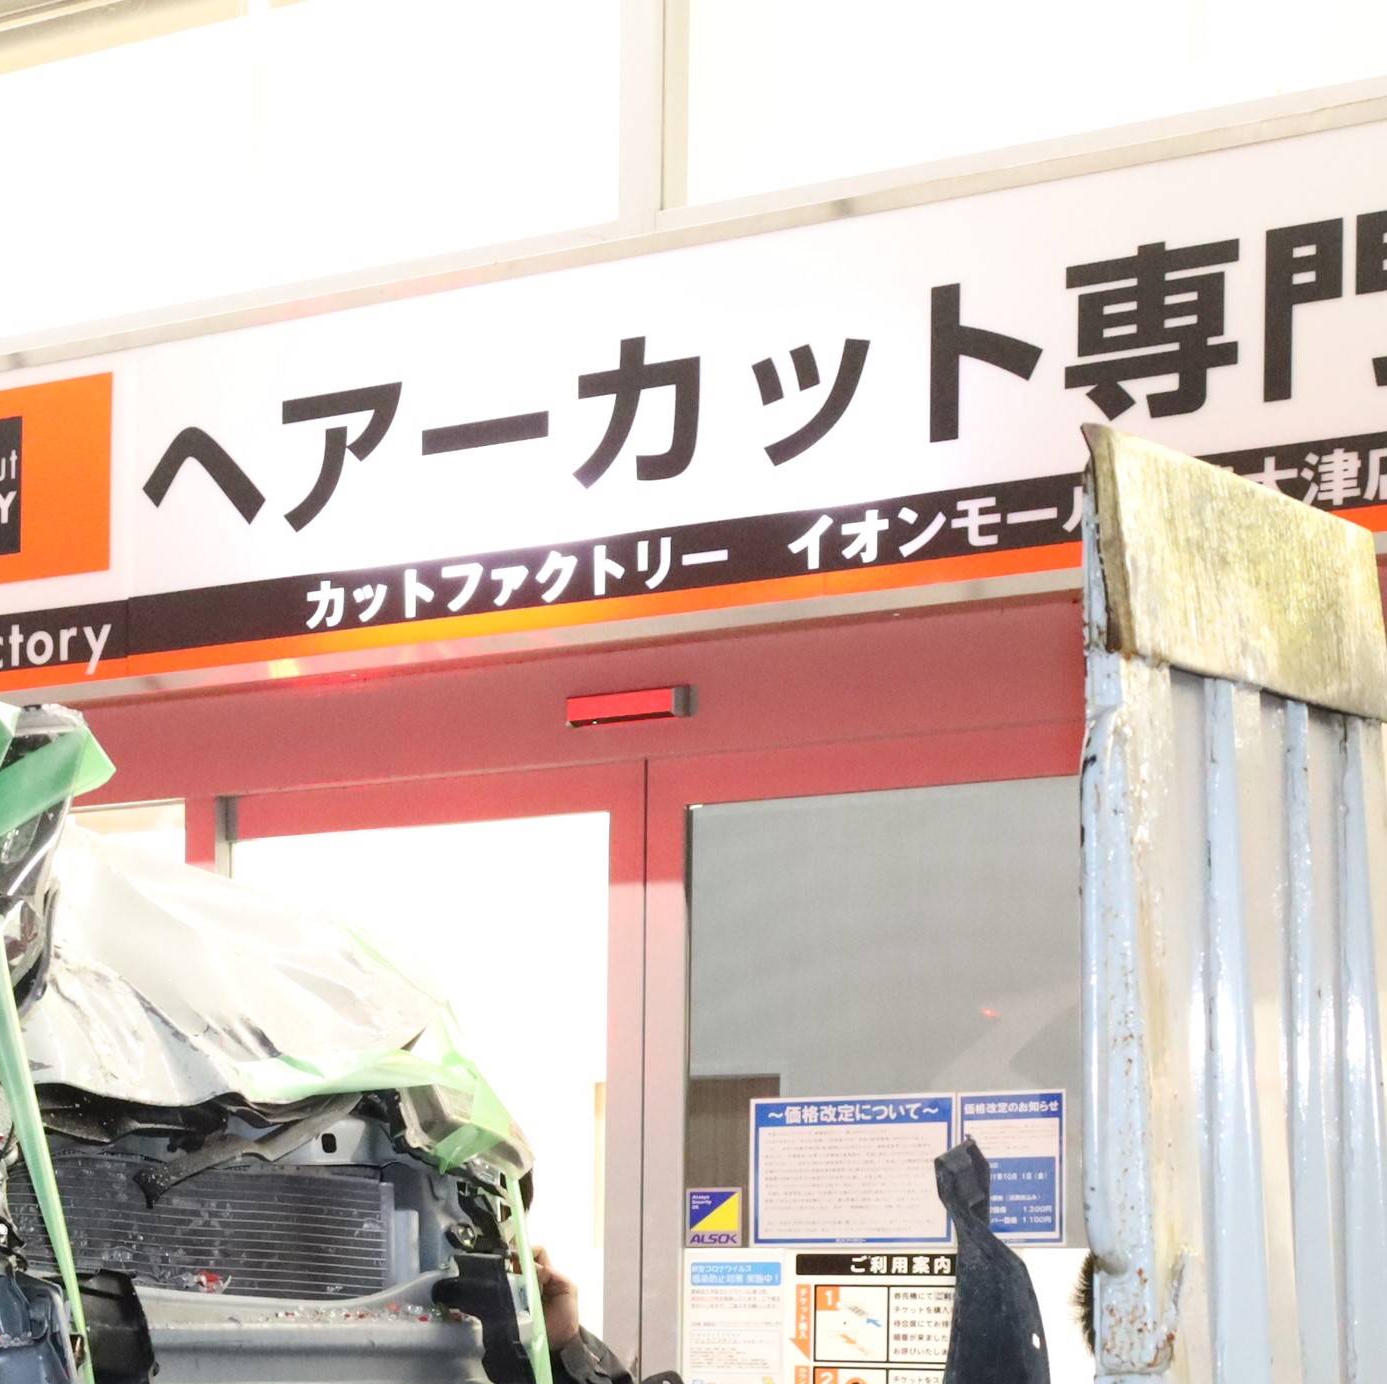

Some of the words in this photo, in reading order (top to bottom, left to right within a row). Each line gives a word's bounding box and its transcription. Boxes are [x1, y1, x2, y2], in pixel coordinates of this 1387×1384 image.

[141, 209, 1387, 533] ヘアーカット専門
[305, 536, 729, 630] カットファクトリー
[1209, 448, 1387, 506] 大津
[964, 1100, 1059, 1115] 価格改定のお知らせ
[689, 1233, 738, 1244] ALSOK
[850, 1255, 952, 1274] ご利用案内
[824, 1290, 834, 1306] 1
[893, 1292, 955, 1301] 券売機にてご利
[893, 1306, 954, 1314] チケットを購入
